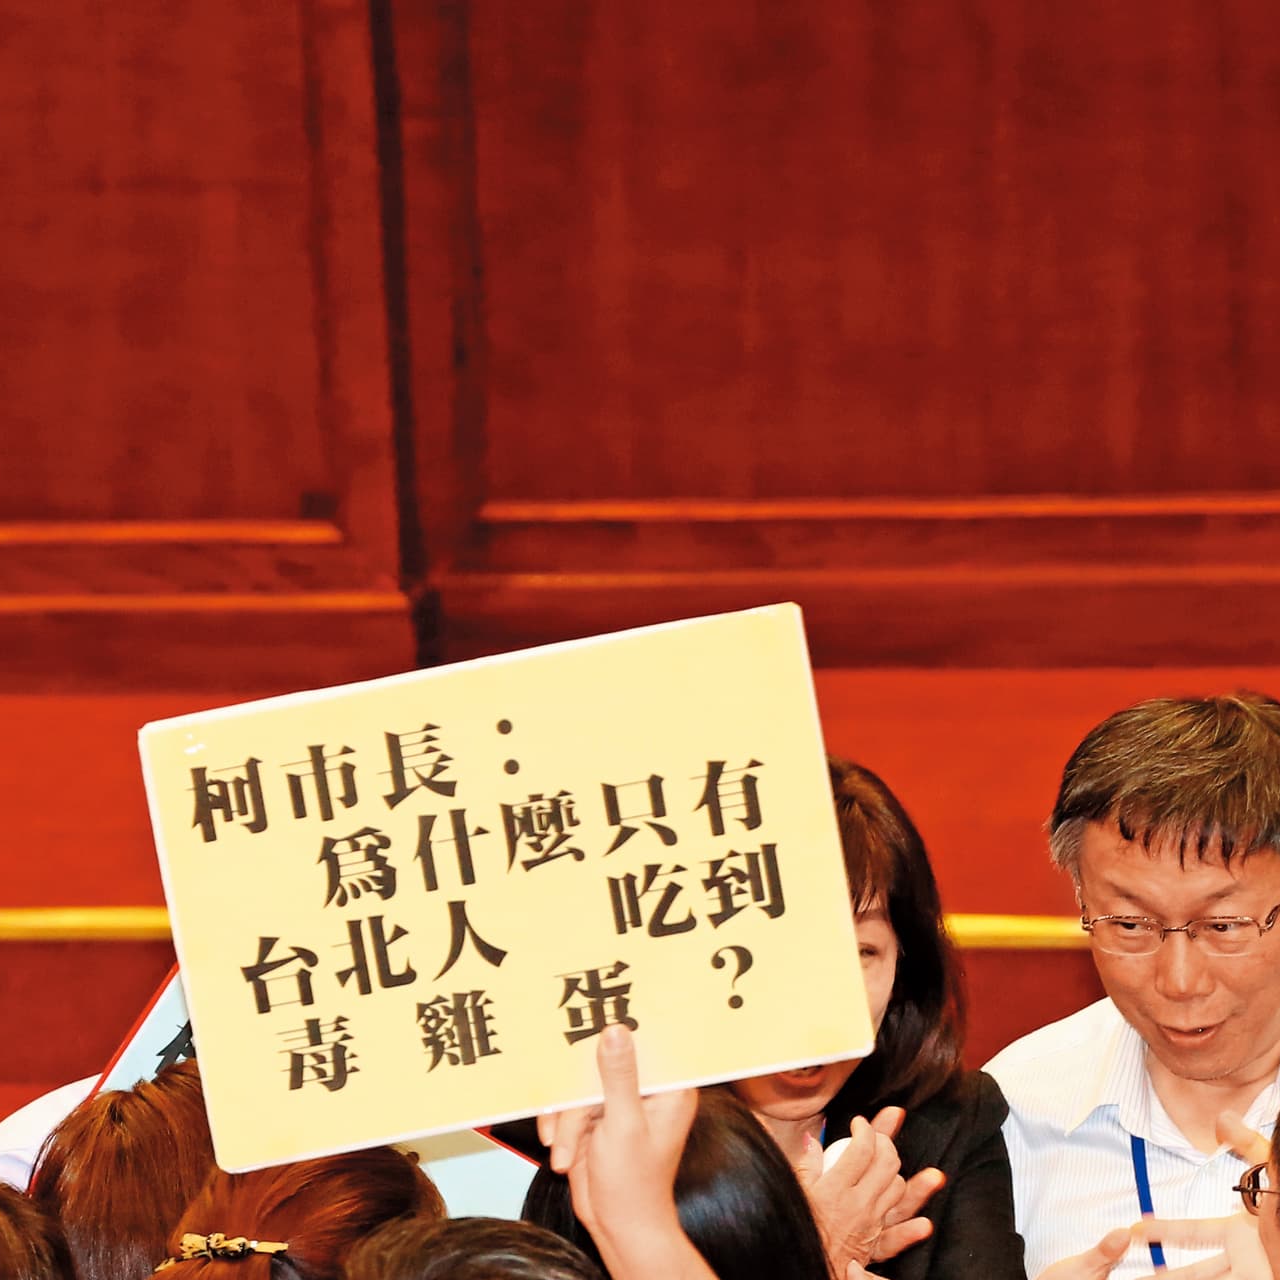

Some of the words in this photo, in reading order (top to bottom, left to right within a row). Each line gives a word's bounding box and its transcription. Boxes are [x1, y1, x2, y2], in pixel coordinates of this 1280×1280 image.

[241, 900, 508, 1014] 台北人
[606, 842, 787, 939] 吃到
